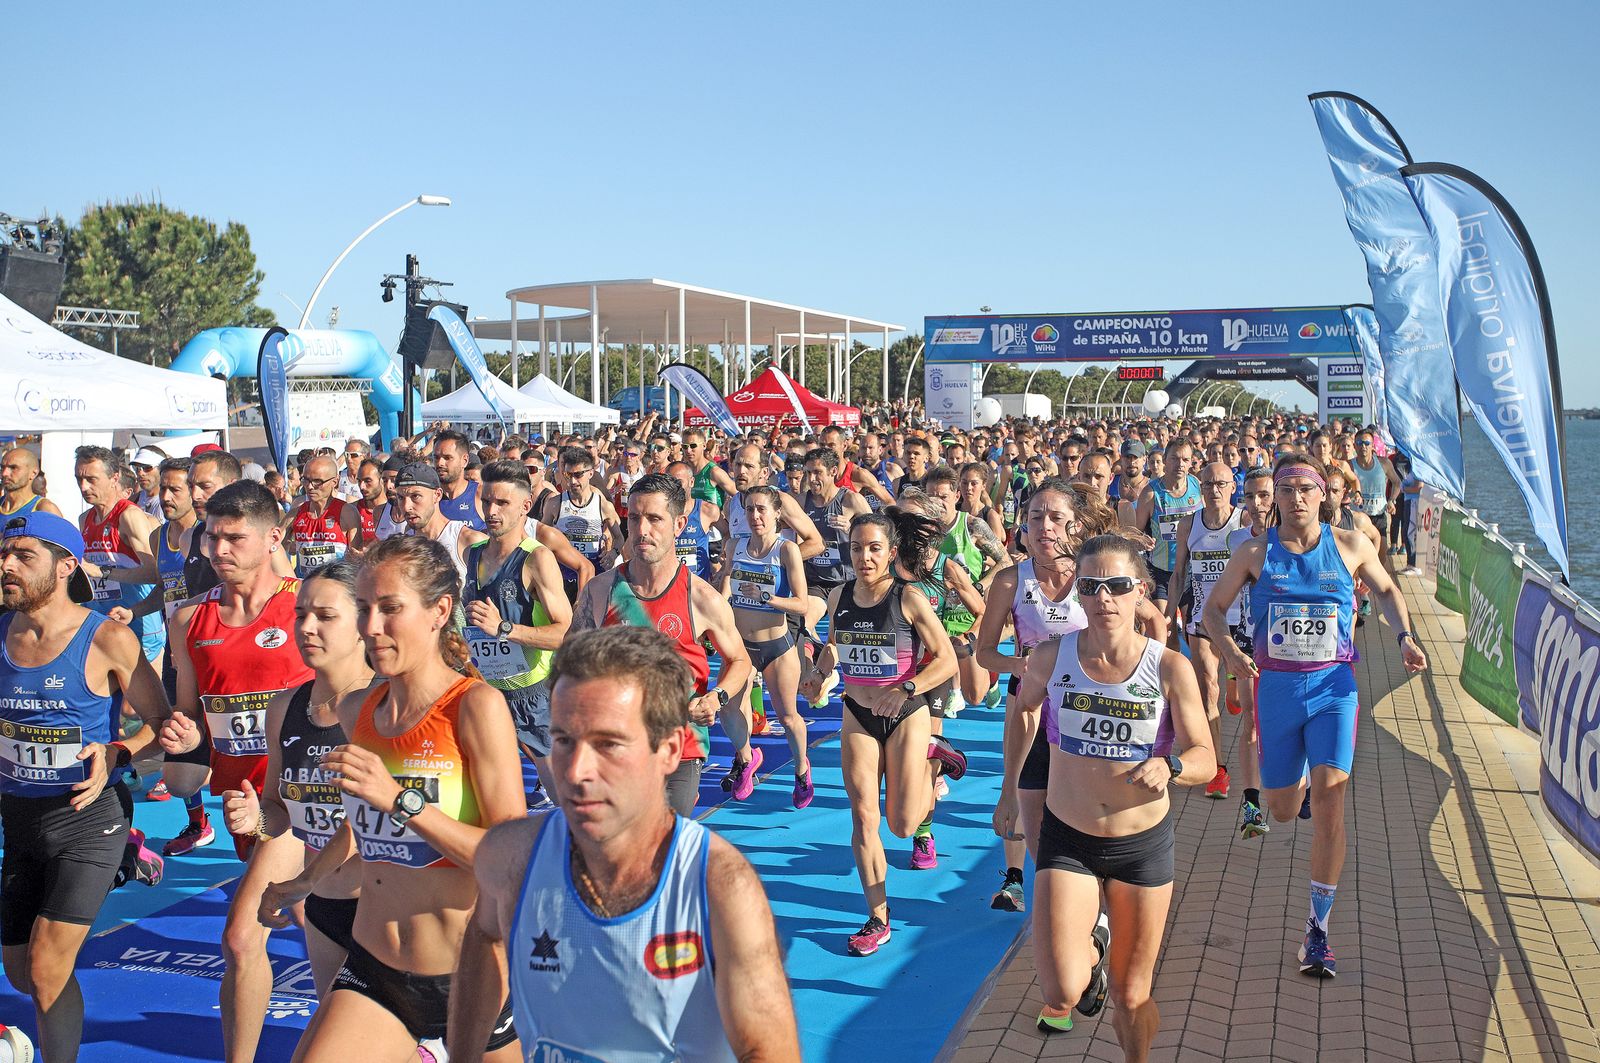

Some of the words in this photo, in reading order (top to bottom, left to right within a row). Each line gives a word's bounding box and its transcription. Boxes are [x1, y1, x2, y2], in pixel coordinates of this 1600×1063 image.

[1074, 318, 1172, 330] CAMPEONATO
[1248, 324, 1289, 338] HUELVA
[1325, 325, 1356, 337] WiH
[1073, 335, 1088, 345] de
[1092, 332, 1141, 345] ESPAÑA
[1150, 330, 1172, 346] 10
[1178, 329, 1208, 345] km
[304, 339, 342, 356] HUELVA
[304, 557, 324, 566] 203
[1201, 561, 1225, 573] 360
[1313, 608, 1331, 616] 2023
[1281, 620, 1326, 635] 1629
[472, 641, 511, 657] 1576
[848, 648, 880, 663] 416
[1098, 698, 1146, 710] RUNNING
[1109, 710, 1138, 718] LOOP
[20, 726, 68, 736] RUNNING
[231, 714, 260, 736] 62
[1082, 717, 1132, 742] 490
[13, 744, 53, 766] 111
[403, 759, 454, 770] SERRANO
[306, 784, 340, 794] RUNNI
[320, 795, 341, 803] LOO
[305, 806, 346, 831] 436
[94, 960, 119, 970] de
